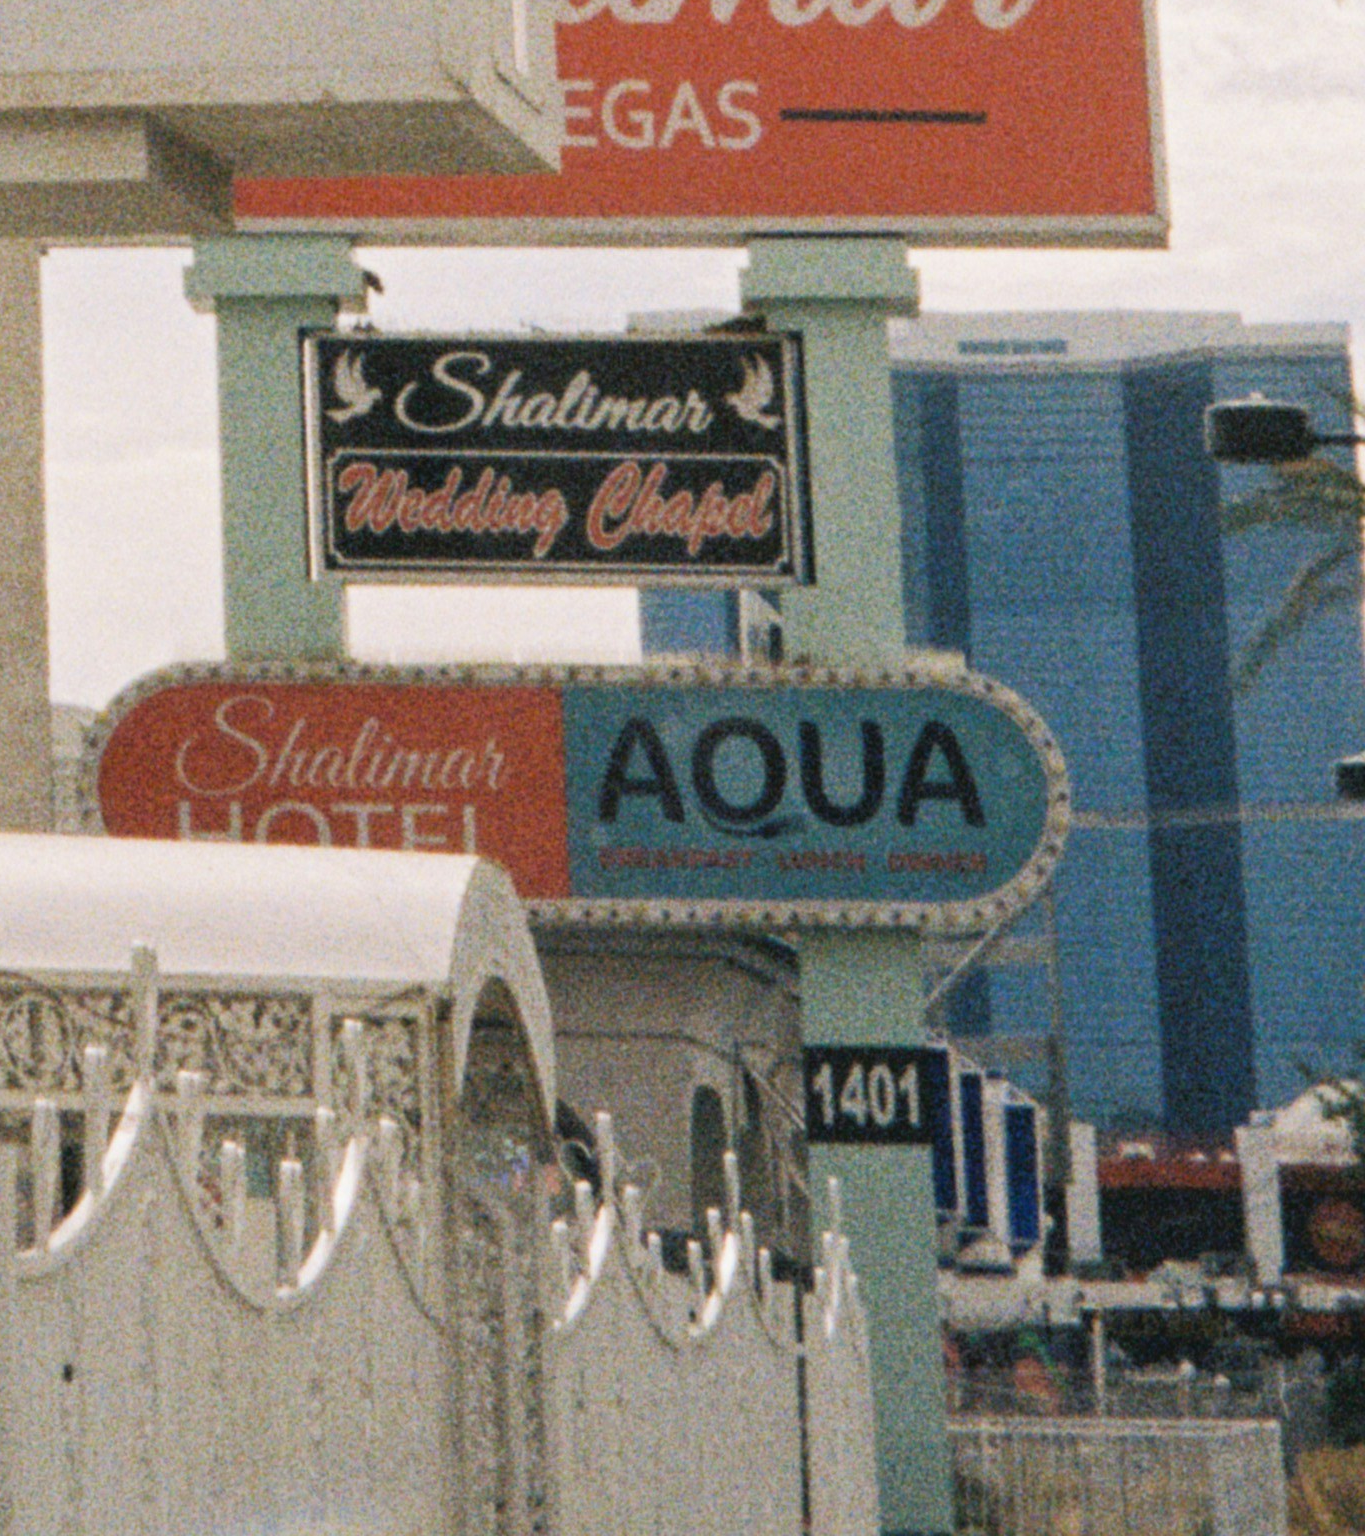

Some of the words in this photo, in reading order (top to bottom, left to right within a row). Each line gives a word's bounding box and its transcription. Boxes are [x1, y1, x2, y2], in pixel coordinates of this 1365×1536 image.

[561, 79, 763, 150] EGAS
[395, 351, 713, 433] Shalimar
[338, 463, 567, 558] Wedding
[587, 461, 776, 556] Chapel
[176, 695, 505, 796] Shalimar
[598, 716, 987, 839] AQUA
[813, 1063, 920, 1128] 1401
